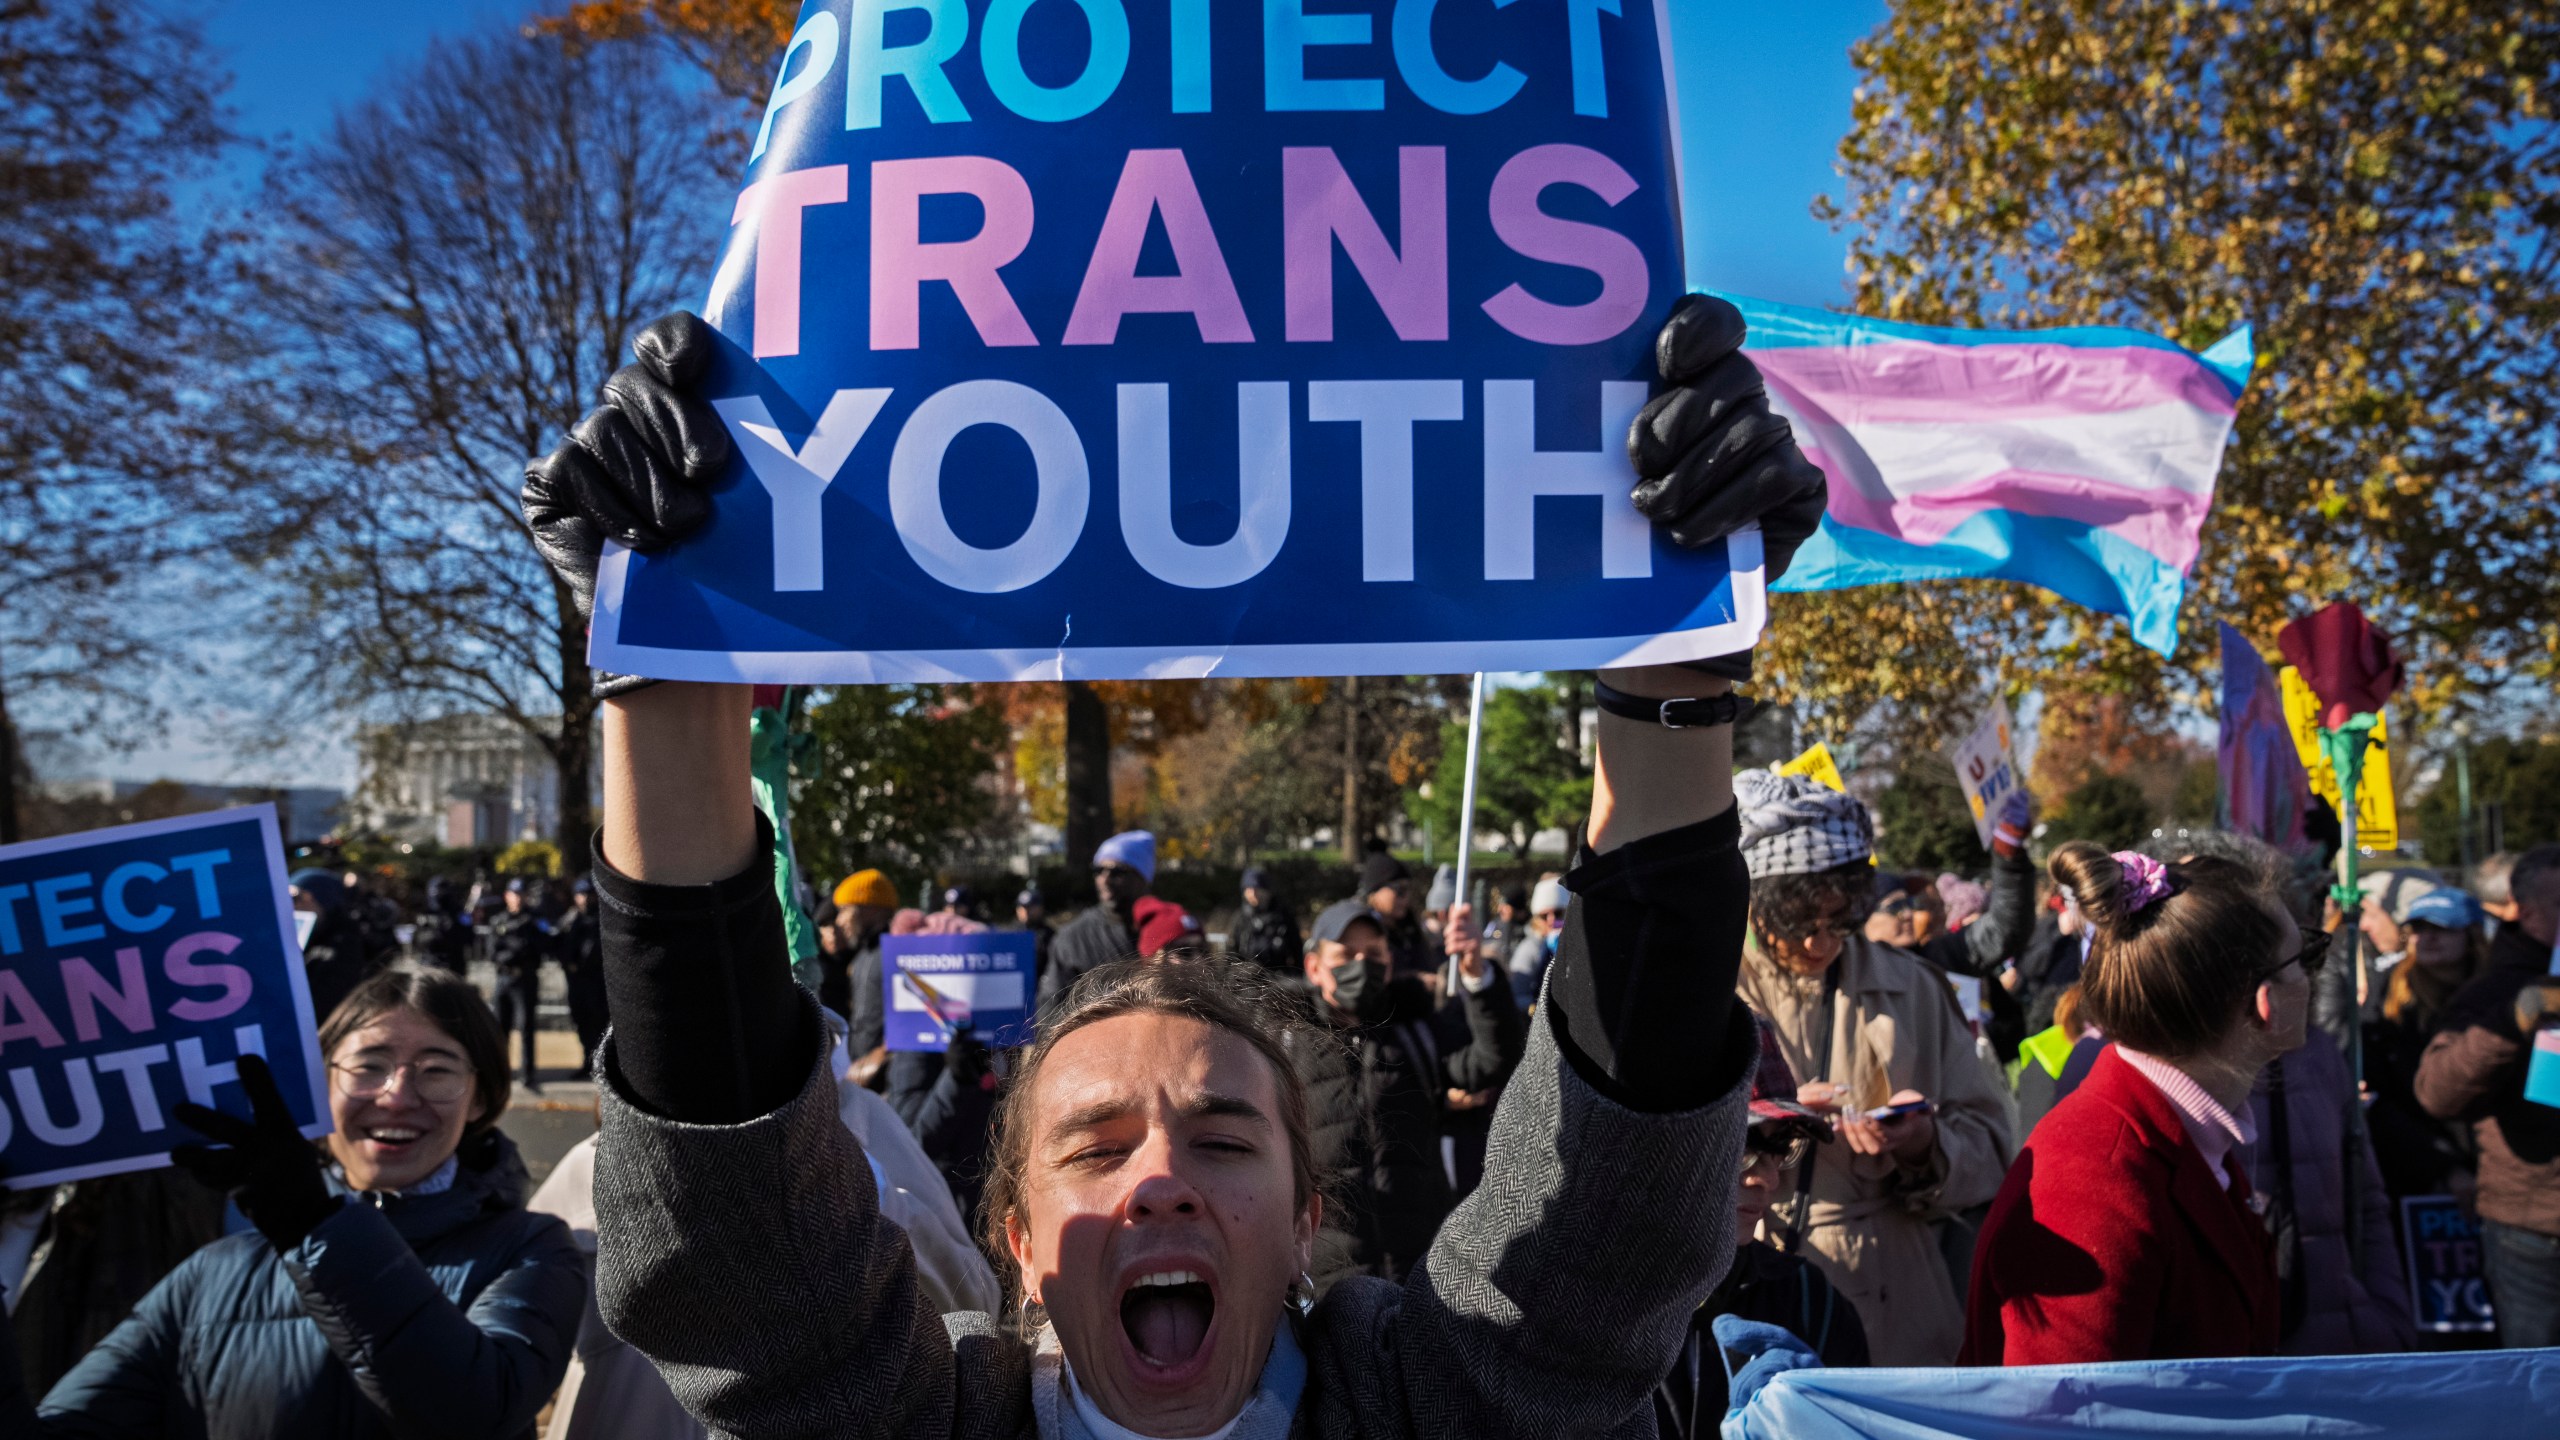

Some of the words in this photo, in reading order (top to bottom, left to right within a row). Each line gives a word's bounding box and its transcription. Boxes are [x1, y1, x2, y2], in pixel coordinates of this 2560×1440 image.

[731, 143, 1650, 358] TRANS
[711, 378, 1653, 593] YOUTH
[896, 953, 965, 971] FREEDOM
[966, 952, 991, 970] TO
[992, 952, 1016, 969] BE
[0, 1024, 267, 1147] UTH
[2418, 1208, 2480, 1237] PR
